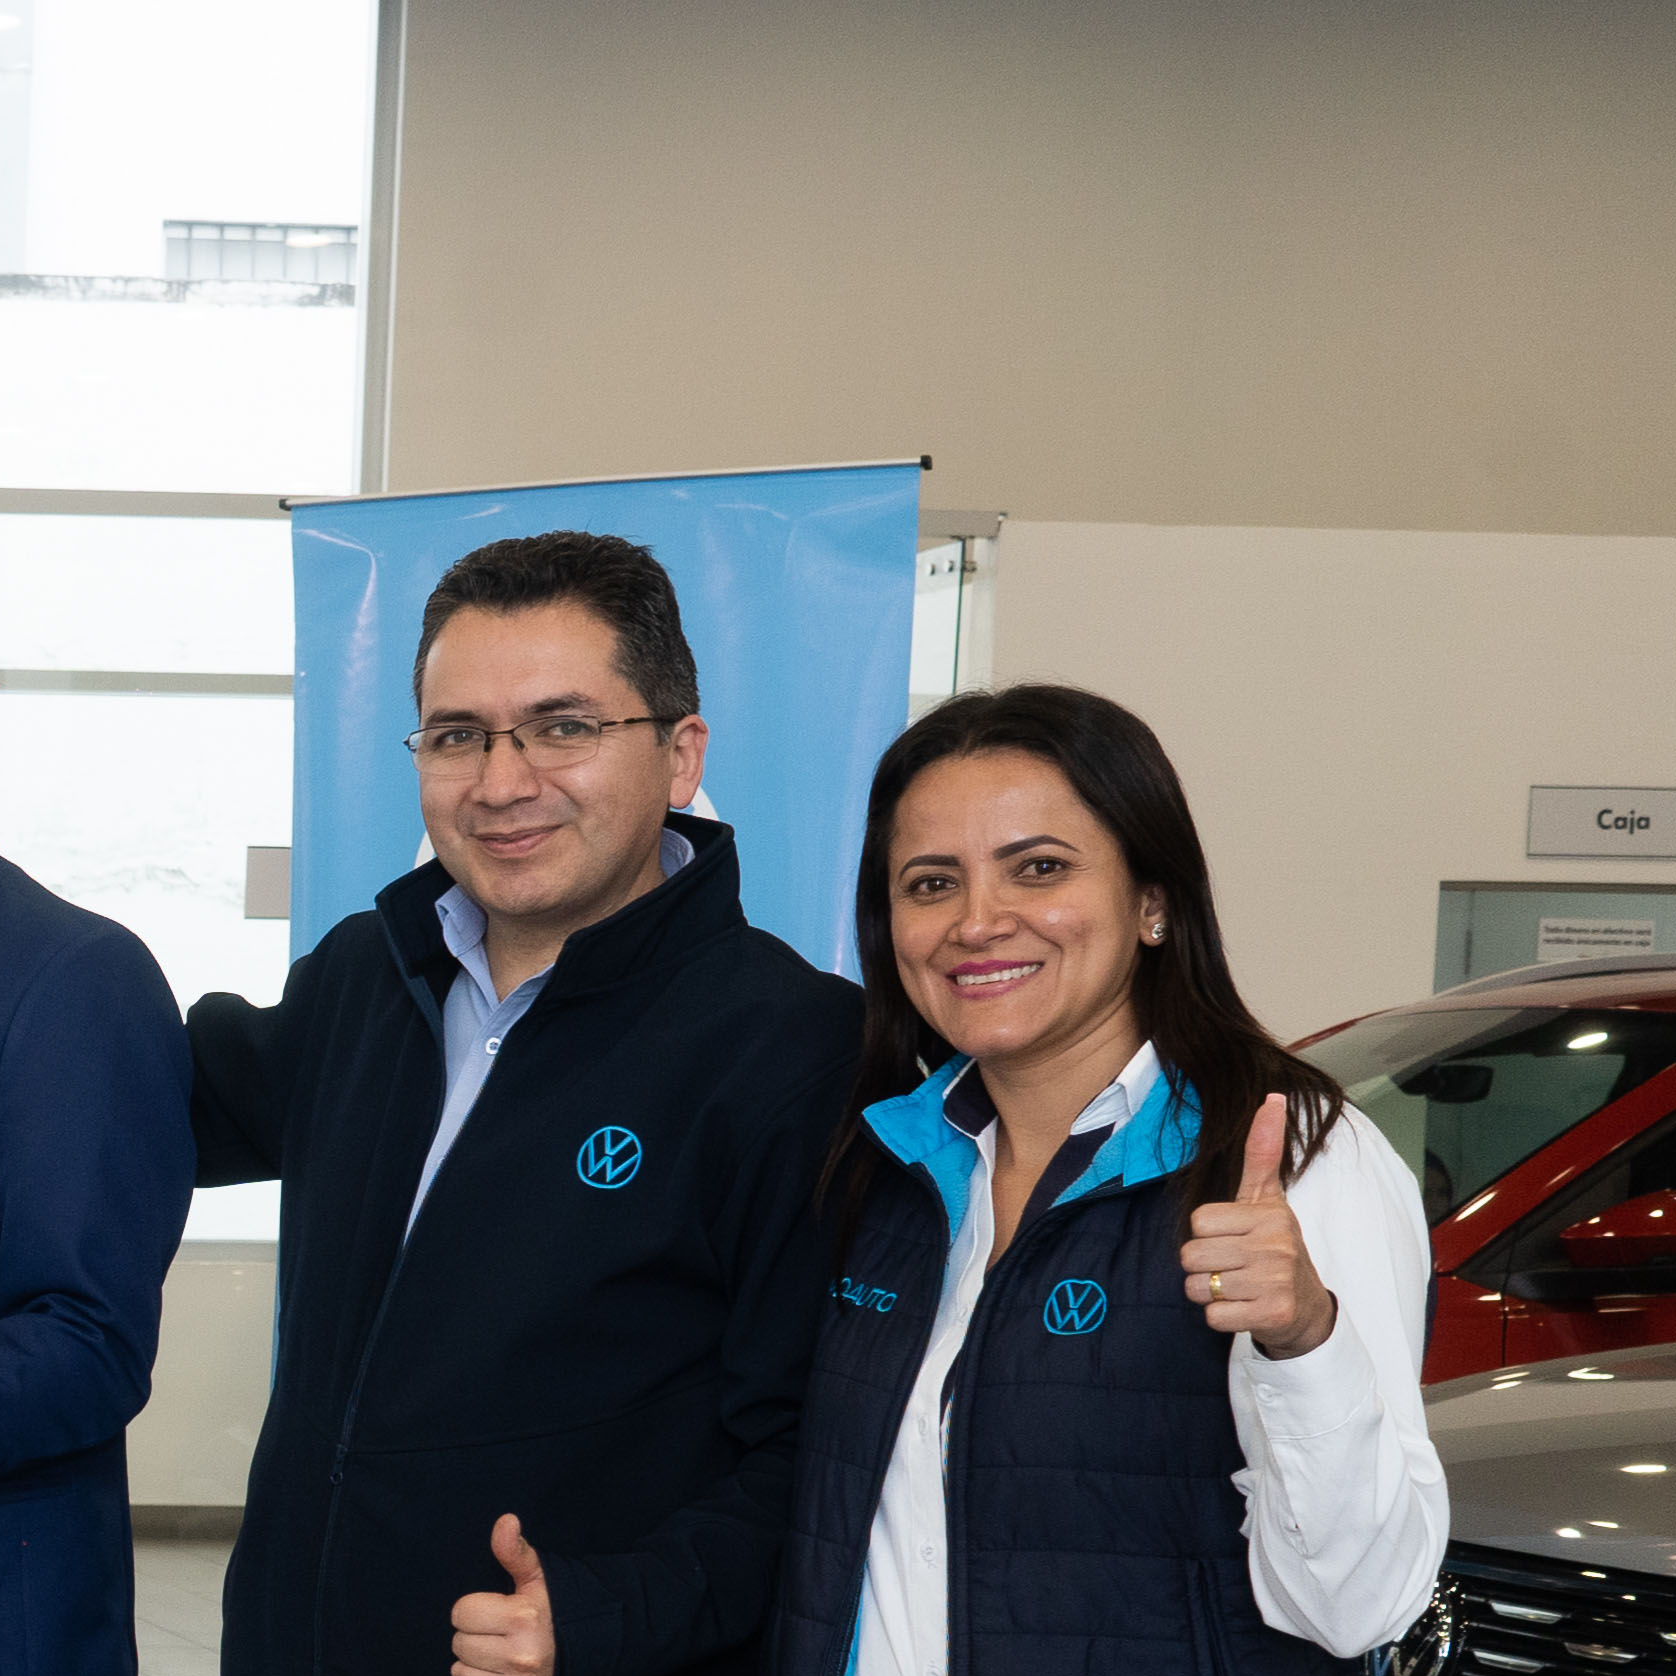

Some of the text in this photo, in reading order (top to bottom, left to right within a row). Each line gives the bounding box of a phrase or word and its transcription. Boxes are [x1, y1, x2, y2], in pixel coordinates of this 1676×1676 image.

[1596, 808, 1651, 835] Caja
[579, 1127, 641, 1184] VW
[1047, 1281, 1106, 1331] VW
